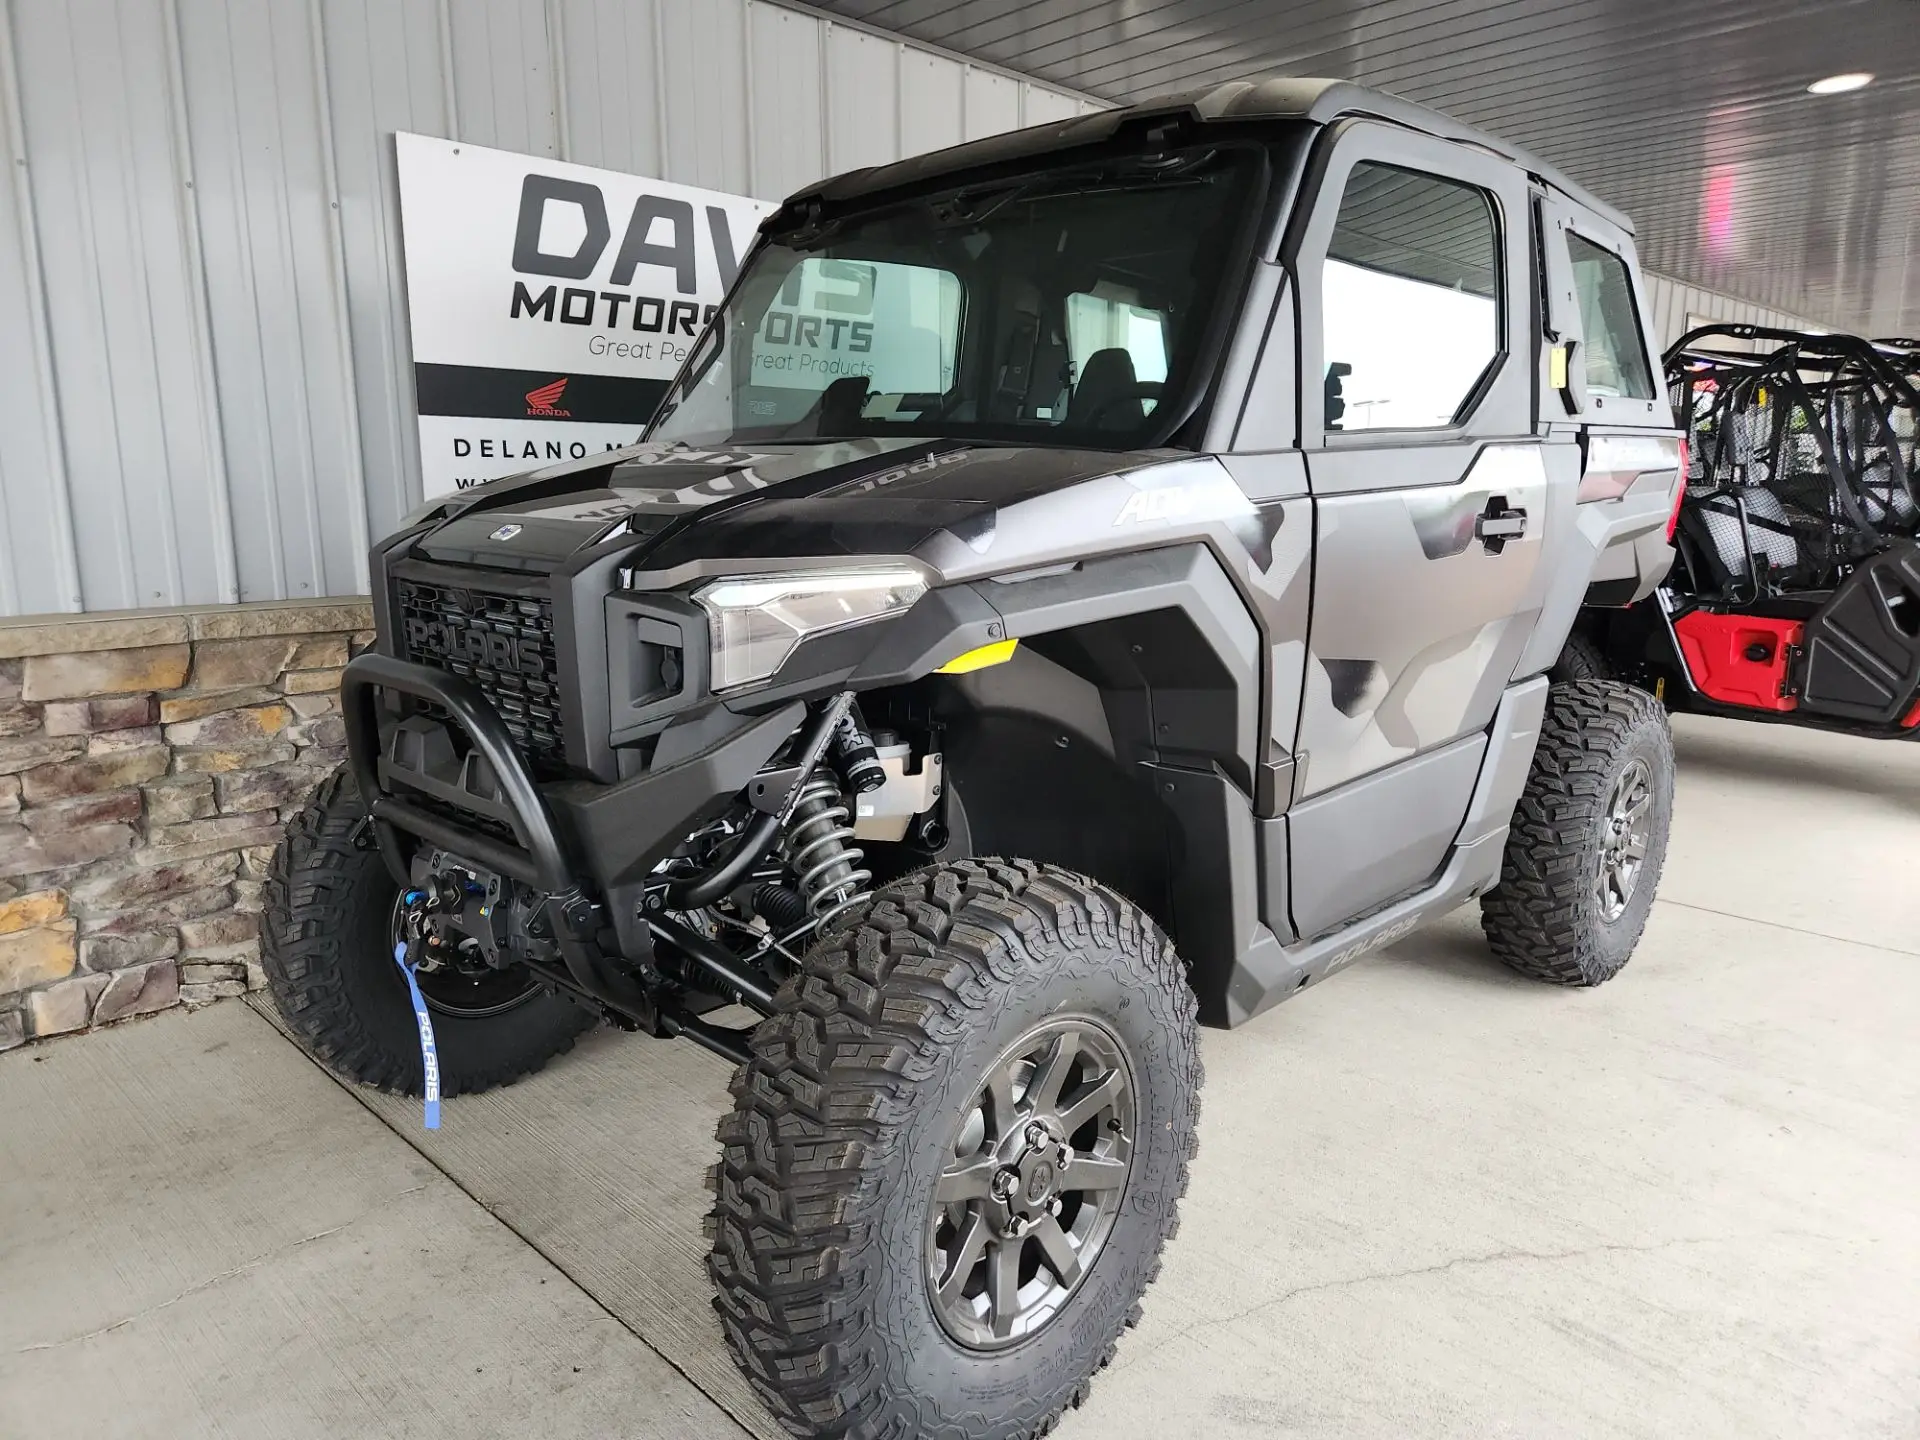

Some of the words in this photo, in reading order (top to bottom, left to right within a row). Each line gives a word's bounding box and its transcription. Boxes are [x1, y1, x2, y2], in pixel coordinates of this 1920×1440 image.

[589, 335, 652, 360] Great
[752, 352, 793, 371] reat
[799, 354, 875, 377] Products
[526, 407, 571, 417] HONDA
[454, 438, 586, 459] DELANO
[408, 617, 544, 676] POLARIS
[838, 712, 864, 751] OX
[1323, 912, 1423, 974] POLARIS
[417, 1011, 438, 1102] POLARIS
